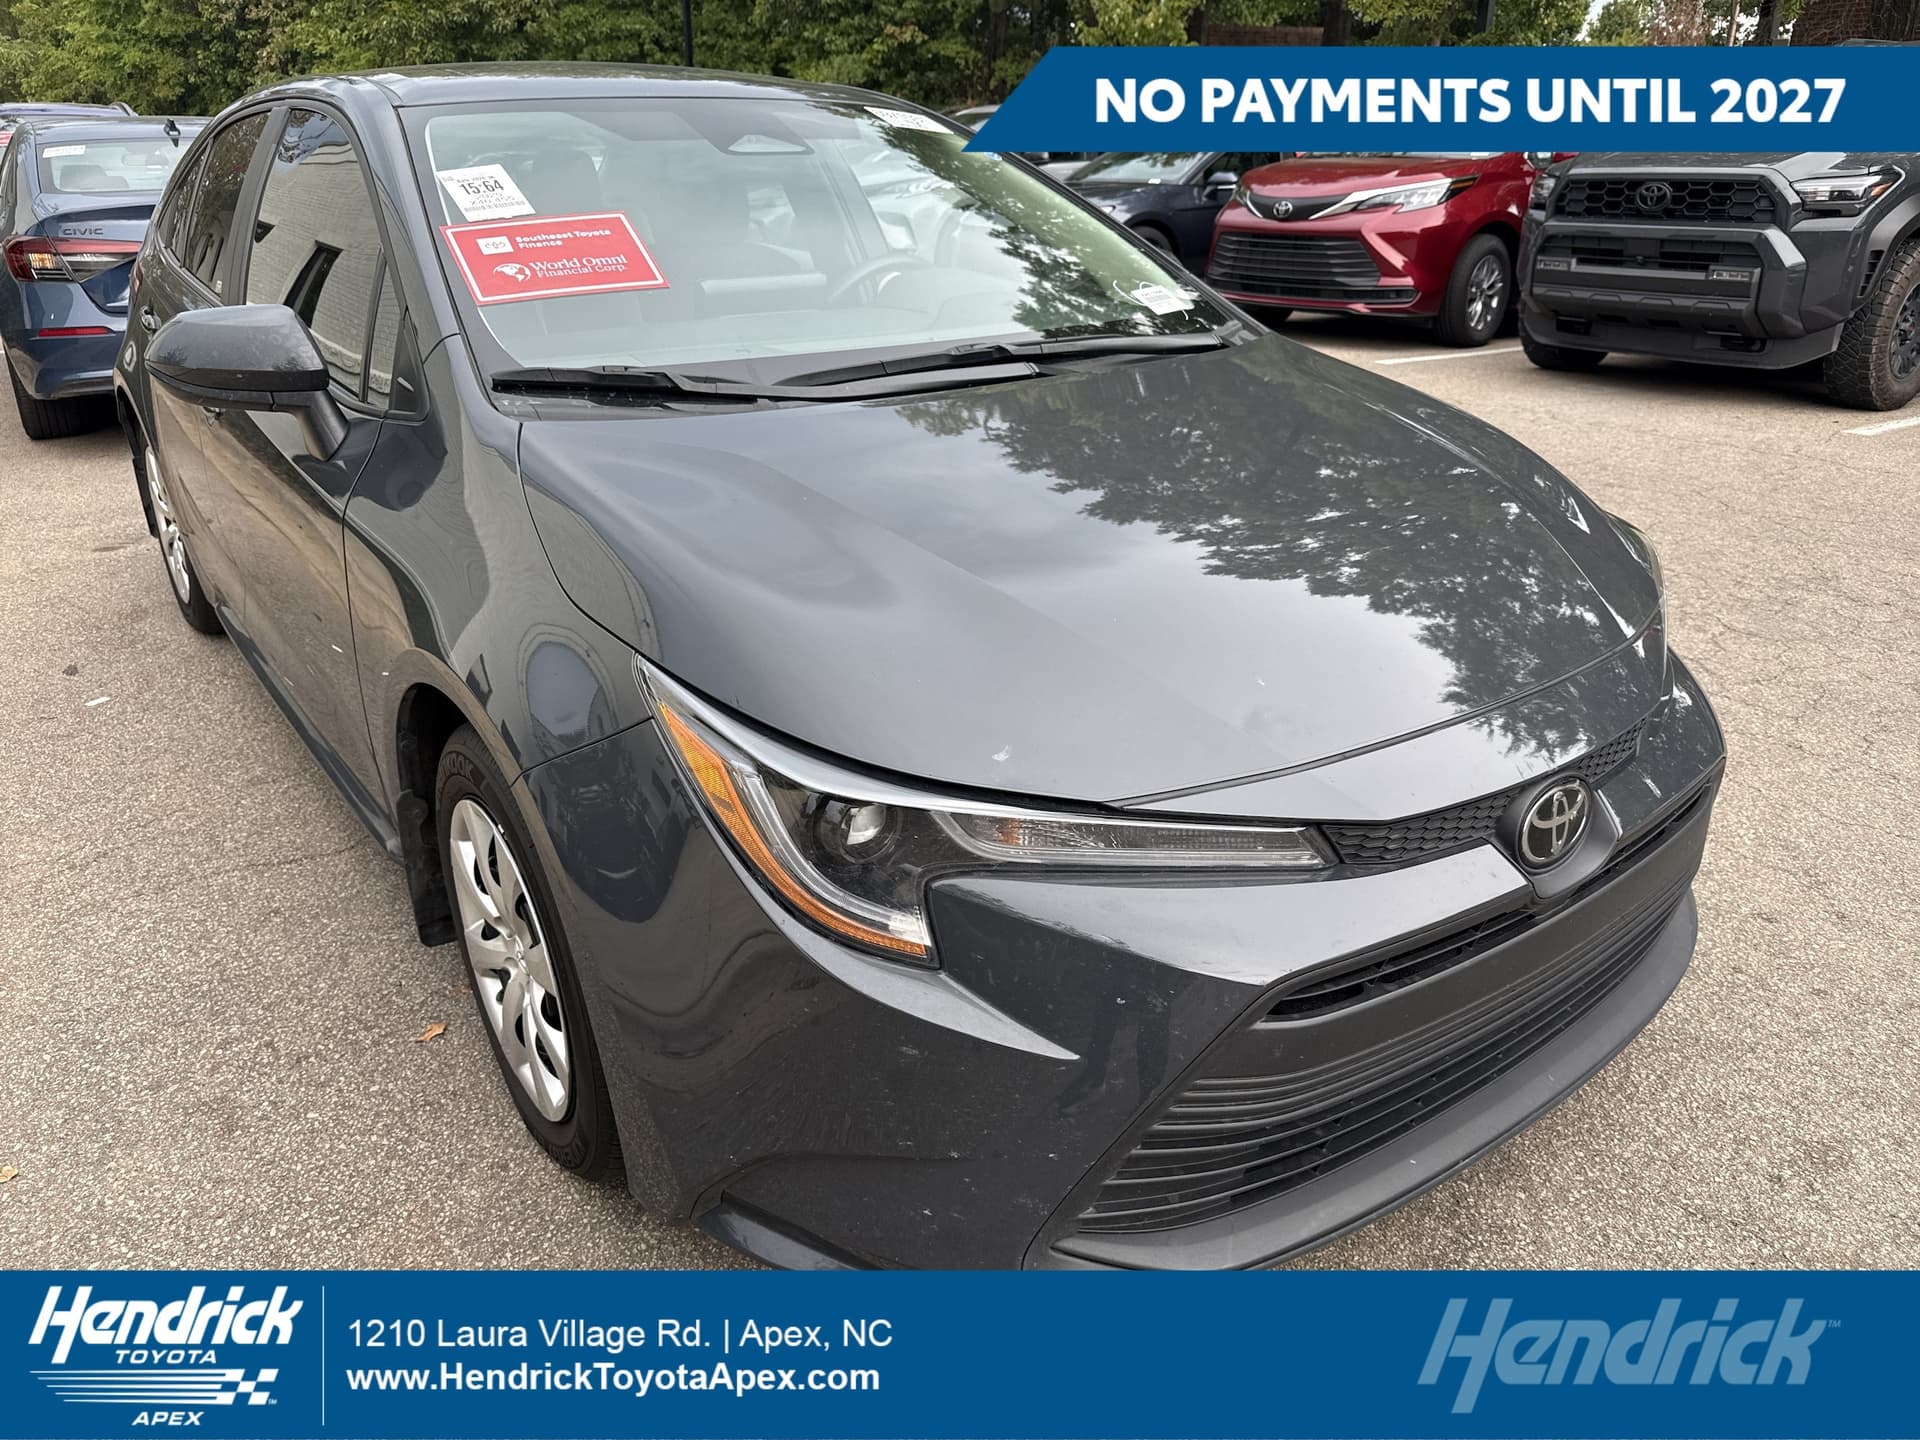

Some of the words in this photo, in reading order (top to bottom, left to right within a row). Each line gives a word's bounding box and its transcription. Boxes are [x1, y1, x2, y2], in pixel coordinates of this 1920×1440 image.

[459, 179, 505, 196] 15:64
[63, 227, 104, 236] CIVIC
[515, 231, 574, 243] Southeast
[574, 229, 612, 239] Toyota
[518, 240, 563, 250] Finance
[529, 256, 582, 271] World
[582, 254, 628, 267] Omni
[536, 265, 594, 279] Financial
